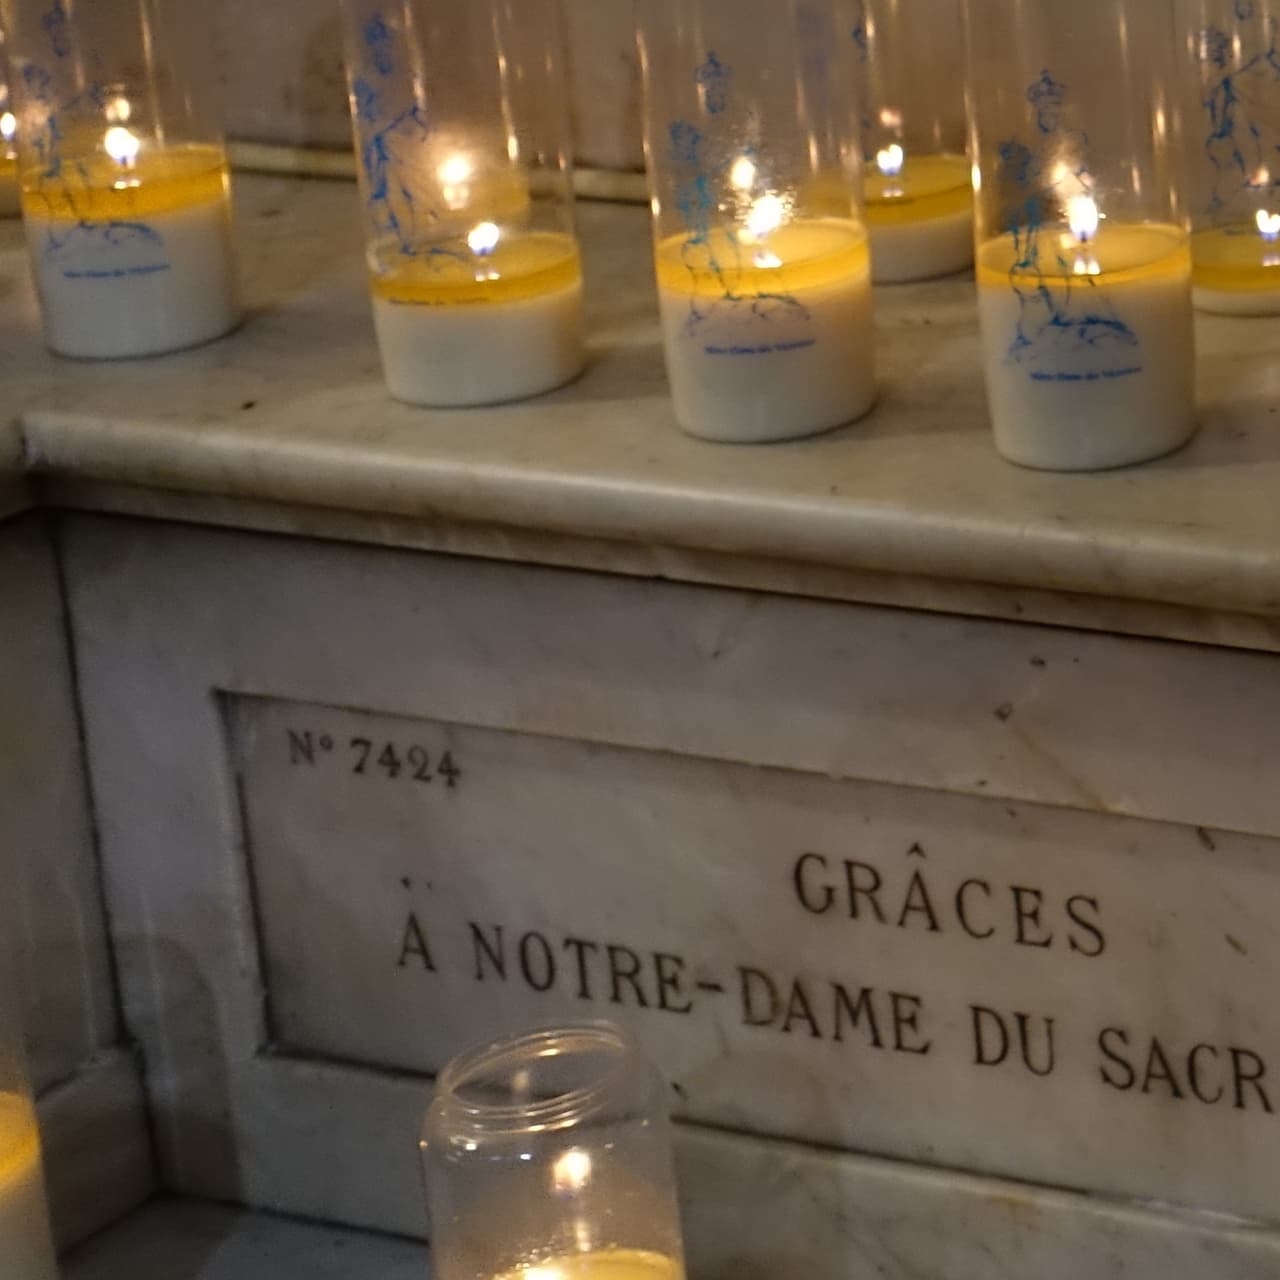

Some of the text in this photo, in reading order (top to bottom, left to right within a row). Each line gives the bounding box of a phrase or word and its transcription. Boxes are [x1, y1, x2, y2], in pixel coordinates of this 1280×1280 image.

[350, 734, 460, 788] 7424
[791, 842, 1106, 957] GRÂCES
[468, 920, 932, 1055] NOTRE-DAME
[969, 1005, 1055, 1076] DU
